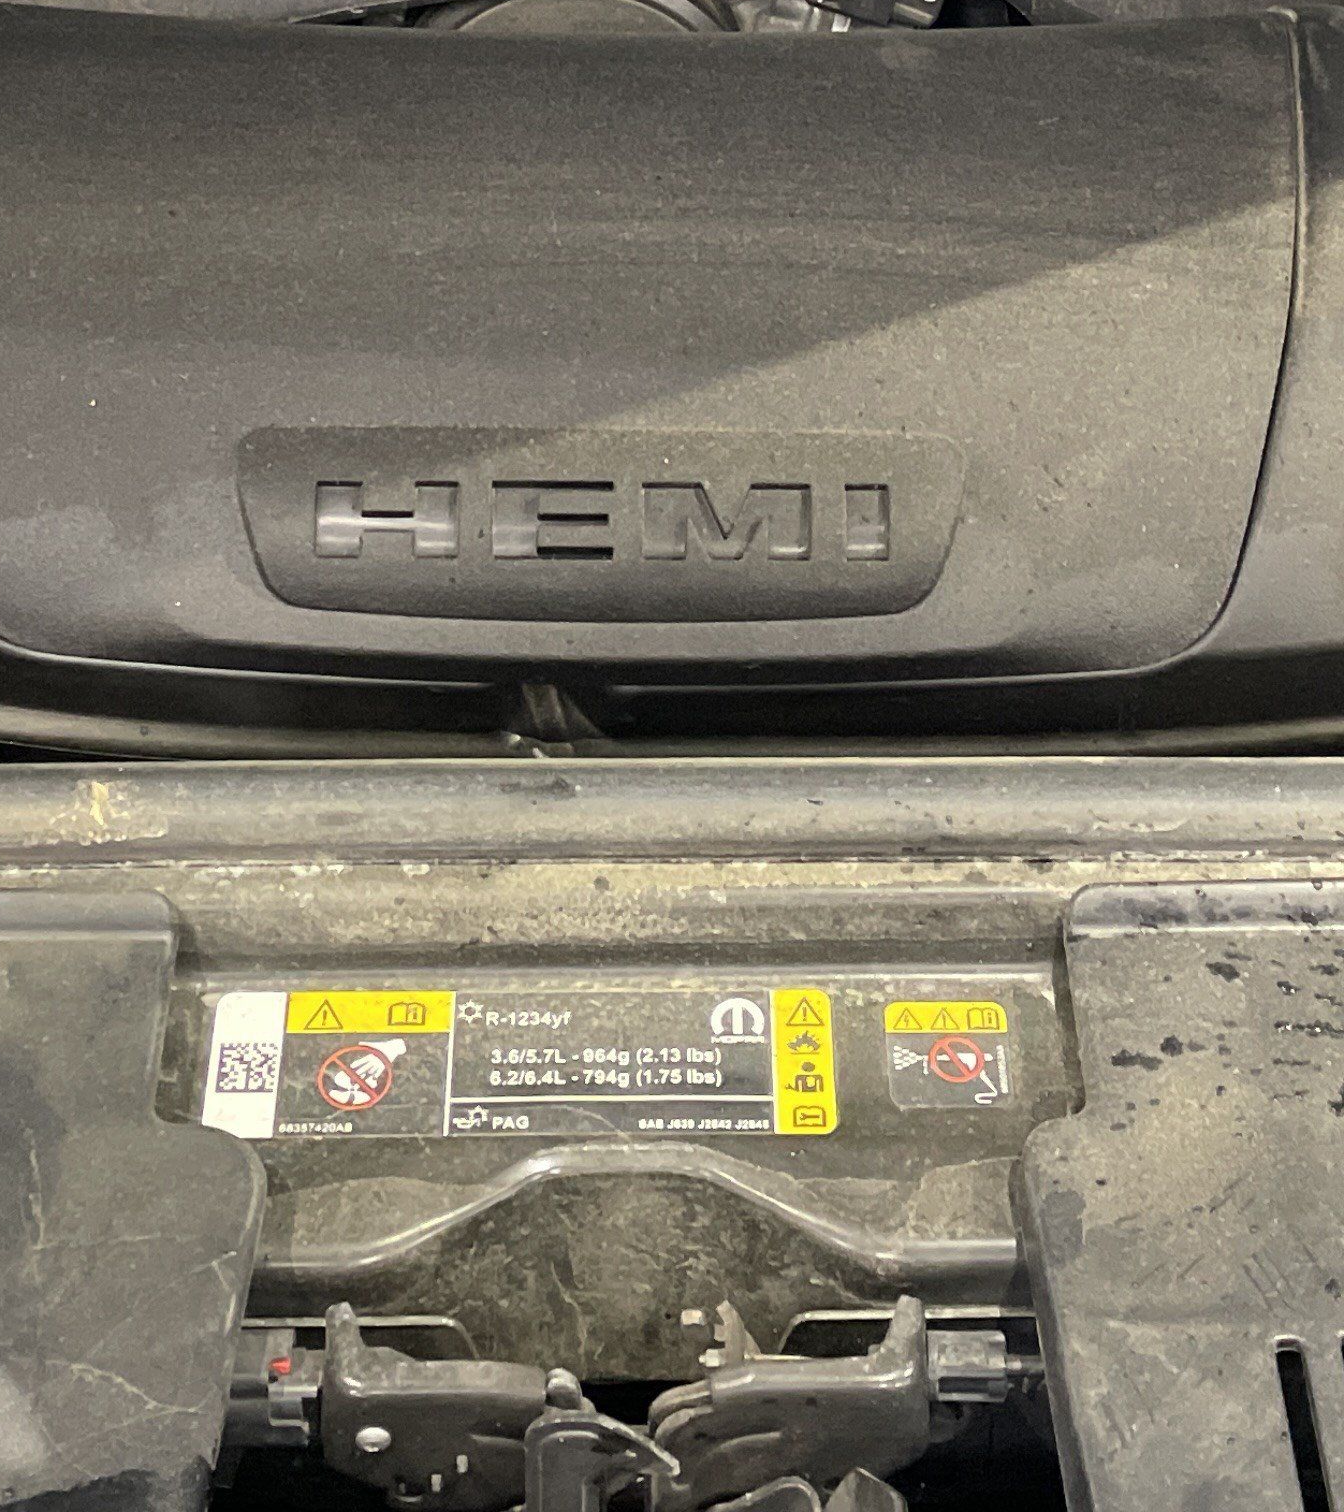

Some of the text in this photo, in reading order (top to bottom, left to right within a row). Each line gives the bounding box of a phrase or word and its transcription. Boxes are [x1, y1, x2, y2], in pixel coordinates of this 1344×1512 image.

[314, 479, 890, 561] HEMI
[485, 1010, 572, 1030] R-1234yf
[490, 1047, 567, 1065] 3.6/5.7L
[636, 1047, 682, 1066] (2.13
[686, 1047, 722, 1066] lbs)
[489, 1068, 567, 1086] 6.2/6.4L
[582, 1068, 630, 1088] 794g
[636, 1068, 683, 1088] (1.75
[686, 1068, 723, 1088] lbs)
[491, 1115, 530, 1130] PAG
